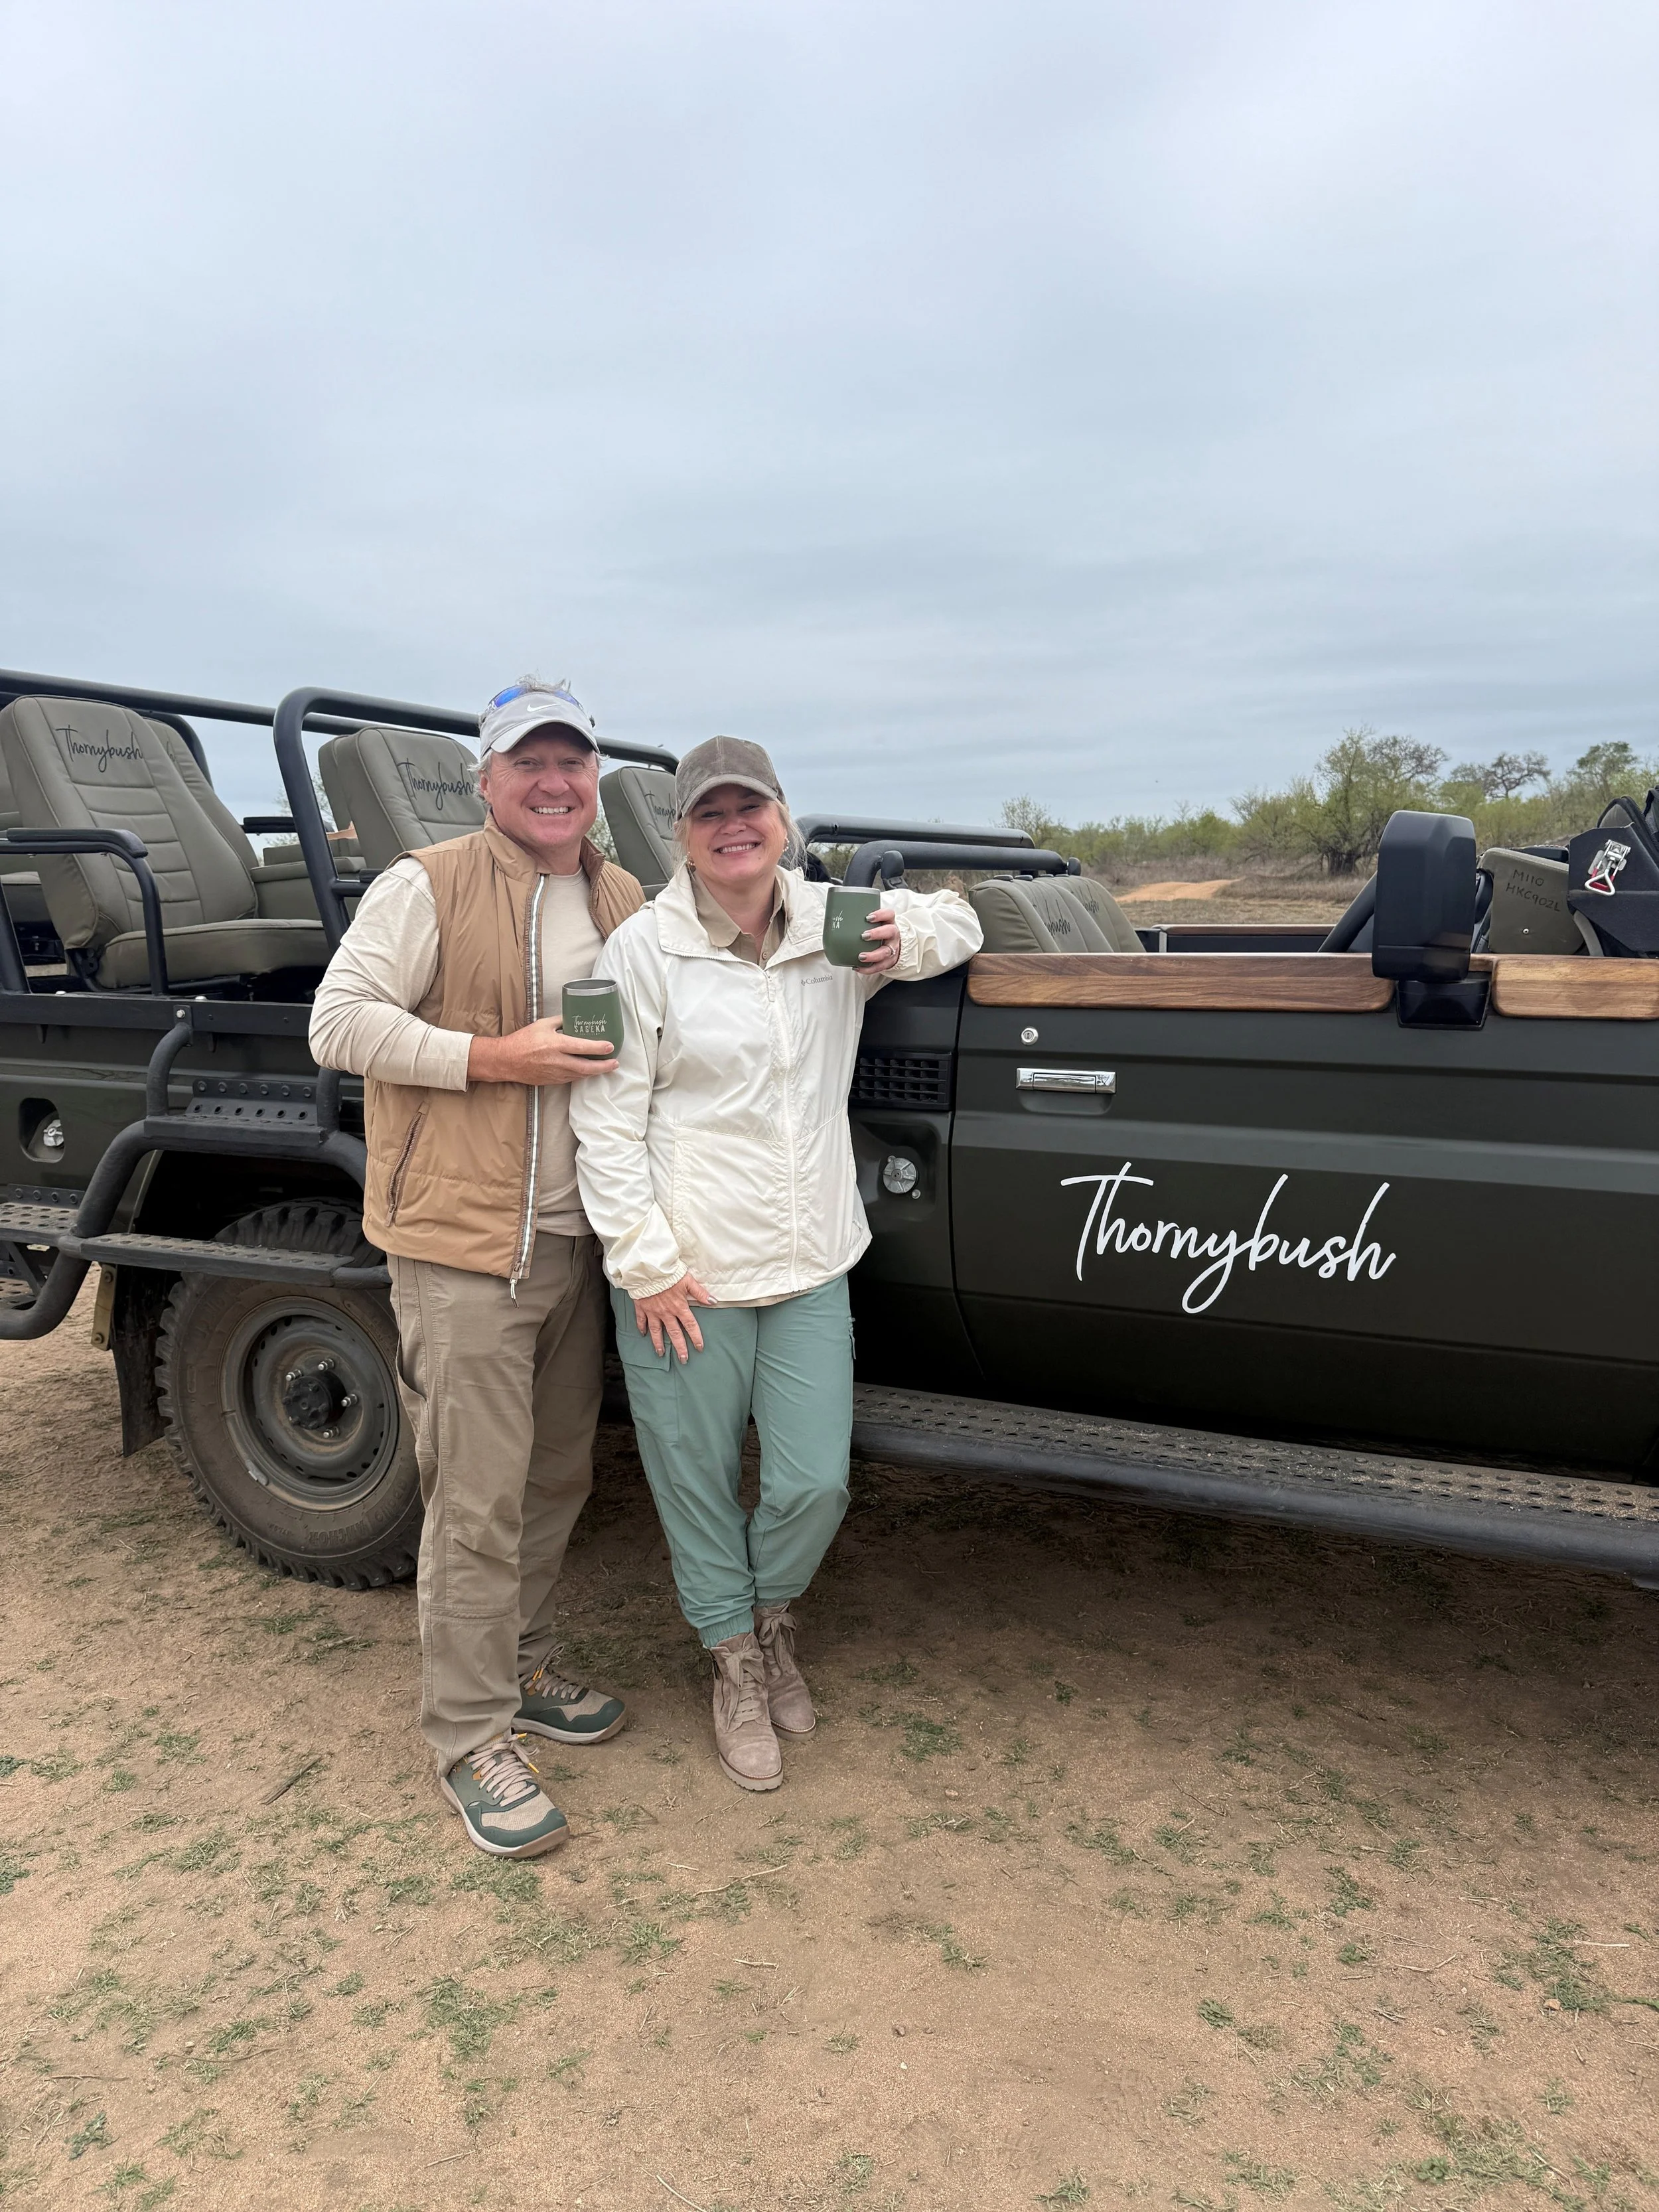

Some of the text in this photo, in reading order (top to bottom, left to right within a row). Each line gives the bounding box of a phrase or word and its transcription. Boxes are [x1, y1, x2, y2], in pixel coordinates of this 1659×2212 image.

[55, 724, 143, 773] Thornybush
[397, 757, 474, 811] Thornybush
[1506, 882, 1561, 912] HKC902L
[806, 975, 833, 985] Columbia
[571, 1013, 607, 1029] Thornybush
[1060, 1161, 1397, 1314] Thornybush
